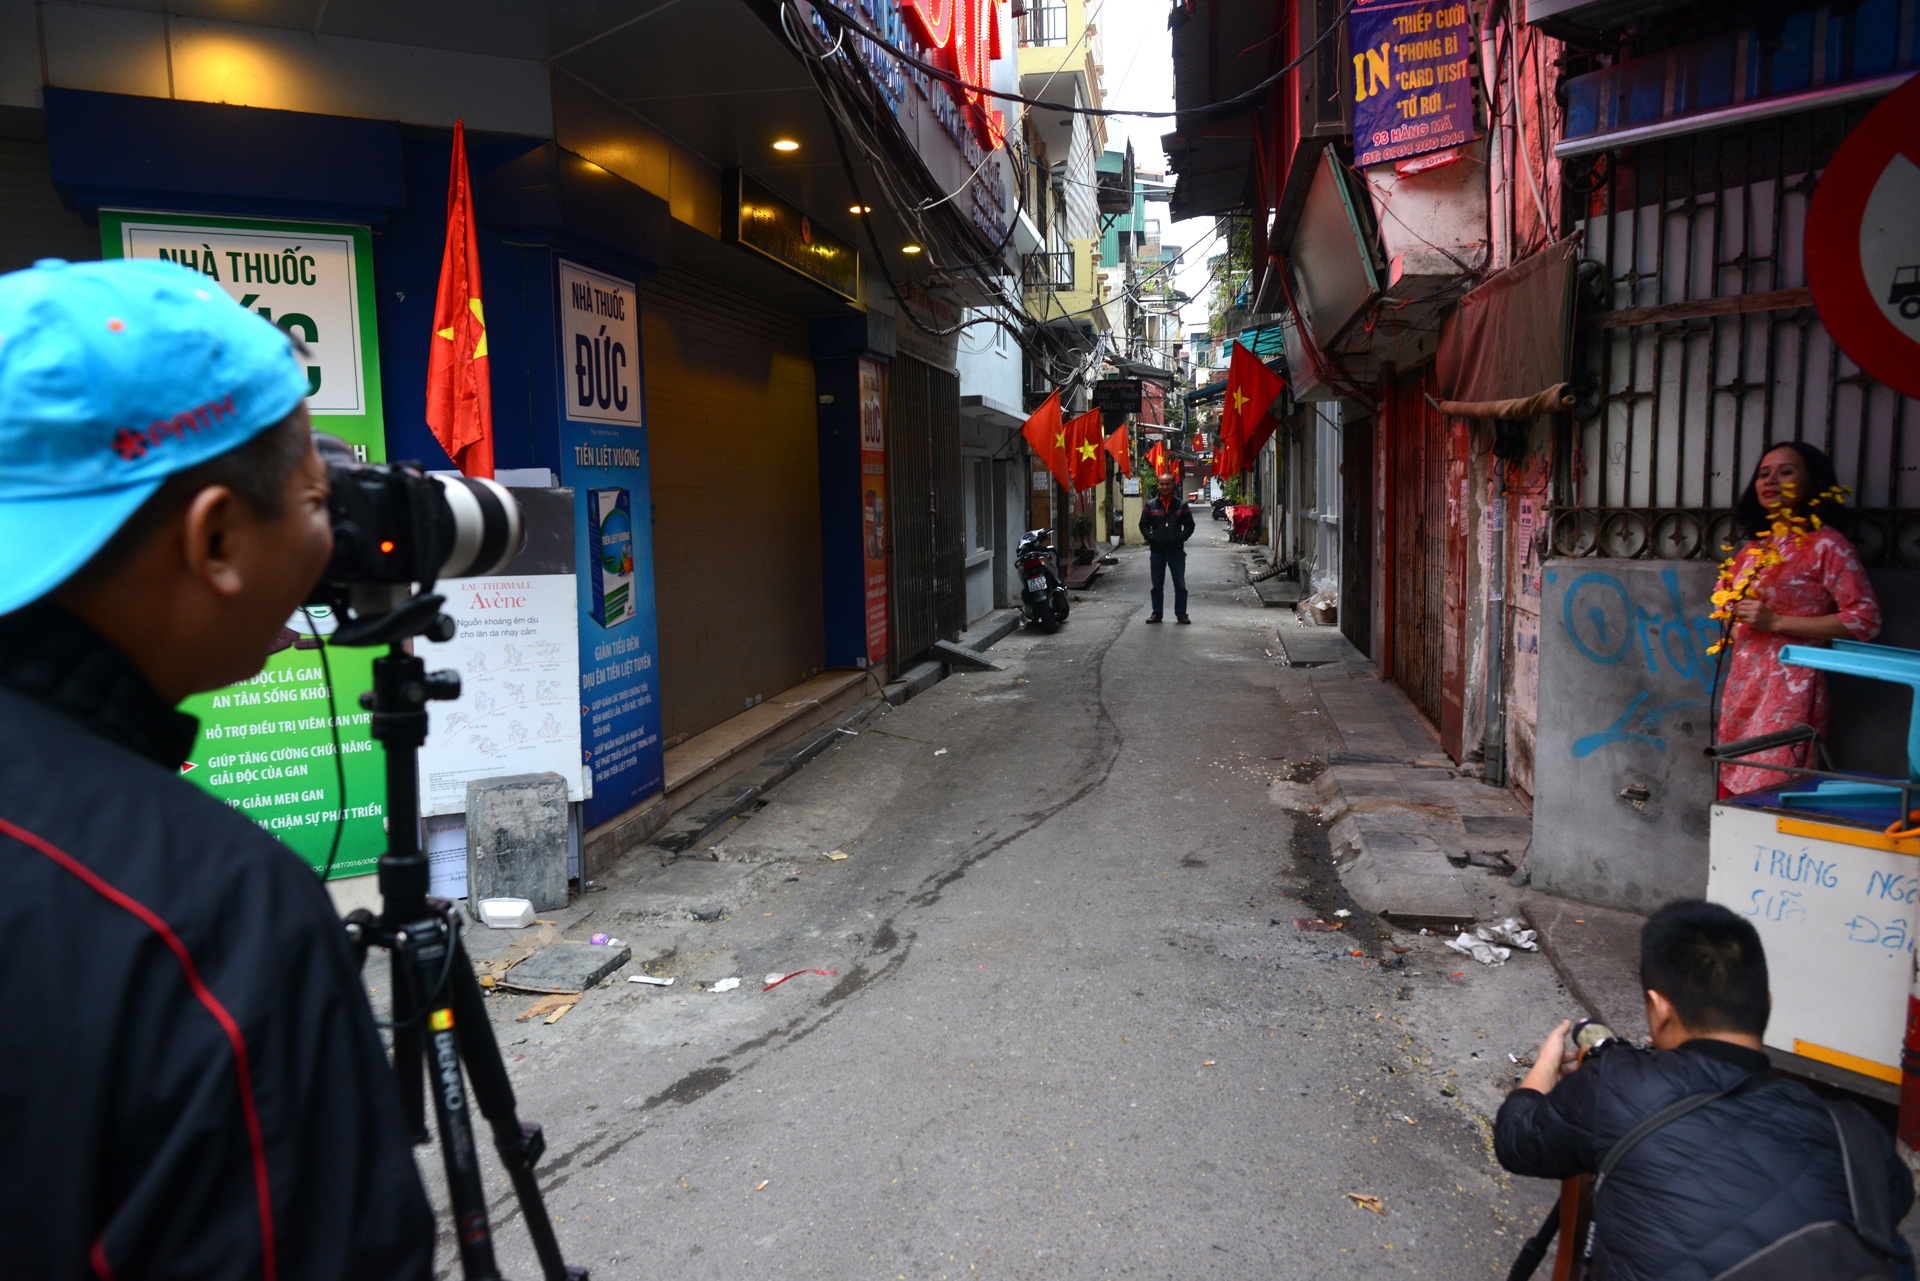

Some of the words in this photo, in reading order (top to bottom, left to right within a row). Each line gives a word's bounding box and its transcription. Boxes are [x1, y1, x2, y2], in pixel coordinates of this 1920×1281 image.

[1436, 3, 1465, 29] CƯỚI
[1445, 32, 1458, 55] BÌ
[1353, 41, 1391, 102] IN
[1437, 59, 1467, 84] VISIT
[1373, 131, 1389, 147] 93
[1391, 123, 1429, 143] HÀNG
[1431, 115, 1453, 134] MÃ
[1362, 152, 1381, 165] ĐT:
[1383, 144, 1413, 160] 0904
[1415, 138, 1439, 153] 300
[1440, 131, 1465, 148] 244
[1421, 154, 1446, 168] 20m
[226, 246, 316, 286] THUỐC
[572, 281, 593, 313] NHÀ
[594, 288, 625, 321] THUỐC
[575, 325, 628, 412] ĐỨC
[1094, 390, 1112, 399] Hair
[1120, 389, 1140, 399] Nails
[1099, 400, 1121, 410] Make
[1123, 402, 1135, 412] up
[864, 395, 881, 443] ĐỨC
[596, 443, 612, 471] LIỆT
[613, 446, 640, 468] VƯƠNG
[461, 583, 480, 591] EAU
[482, 581, 533, 590] THERMALE
[470, 592, 526, 609] Avène
[457, 617, 482, 627] Nguồn
[484, 616, 512, 626] khoáng
[527, 616, 539, 625] dịu
[460, 630, 474, 638] cho
[476, 629, 487, 637] làn
[489, 629, 499, 637] da
[500, 628, 519, 637] nhạy
[520, 627, 537, 635] cảm
[278, 668, 294, 682] LÁ
[296, 668, 322, 681] GAN
[213, 696, 231, 708] AN
[233, 691, 261, 707] TÂM
[263, 686, 298, 704] SỐNG
[206, 724, 222, 740] HỖ
[224, 725, 247, 739] TRỢ
[278, 721, 296, 734] TRỊ
[299, 717, 326, 731] VIÊM
[352, 713, 374, 725] VIR
[208, 753, 236, 769] GIÚP
[238, 750, 268, 765] TĂNG
[270, 747, 309, 762] CƯỜNG
[341, 740, 372, 754] NĂNG
[209, 770, 234, 786] GIẢI
[236, 769, 259, 785] ĐỘC
[260, 765, 283, 780] CỦA
[284, 764, 308, 777] GAN
[223, 797, 240, 810] ÚP
[242, 794, 273, 810] GIẢM
[274, 792, 300, 806] MEN
[301, 789, 324, 801] GAN
[270, 814, 303, 830] CHẬM
[305, 811, 320, 828] SỰ
[351, 801, 382, 818] TRIỂN
[1754, 846, 1838, 888] TRỨNG
